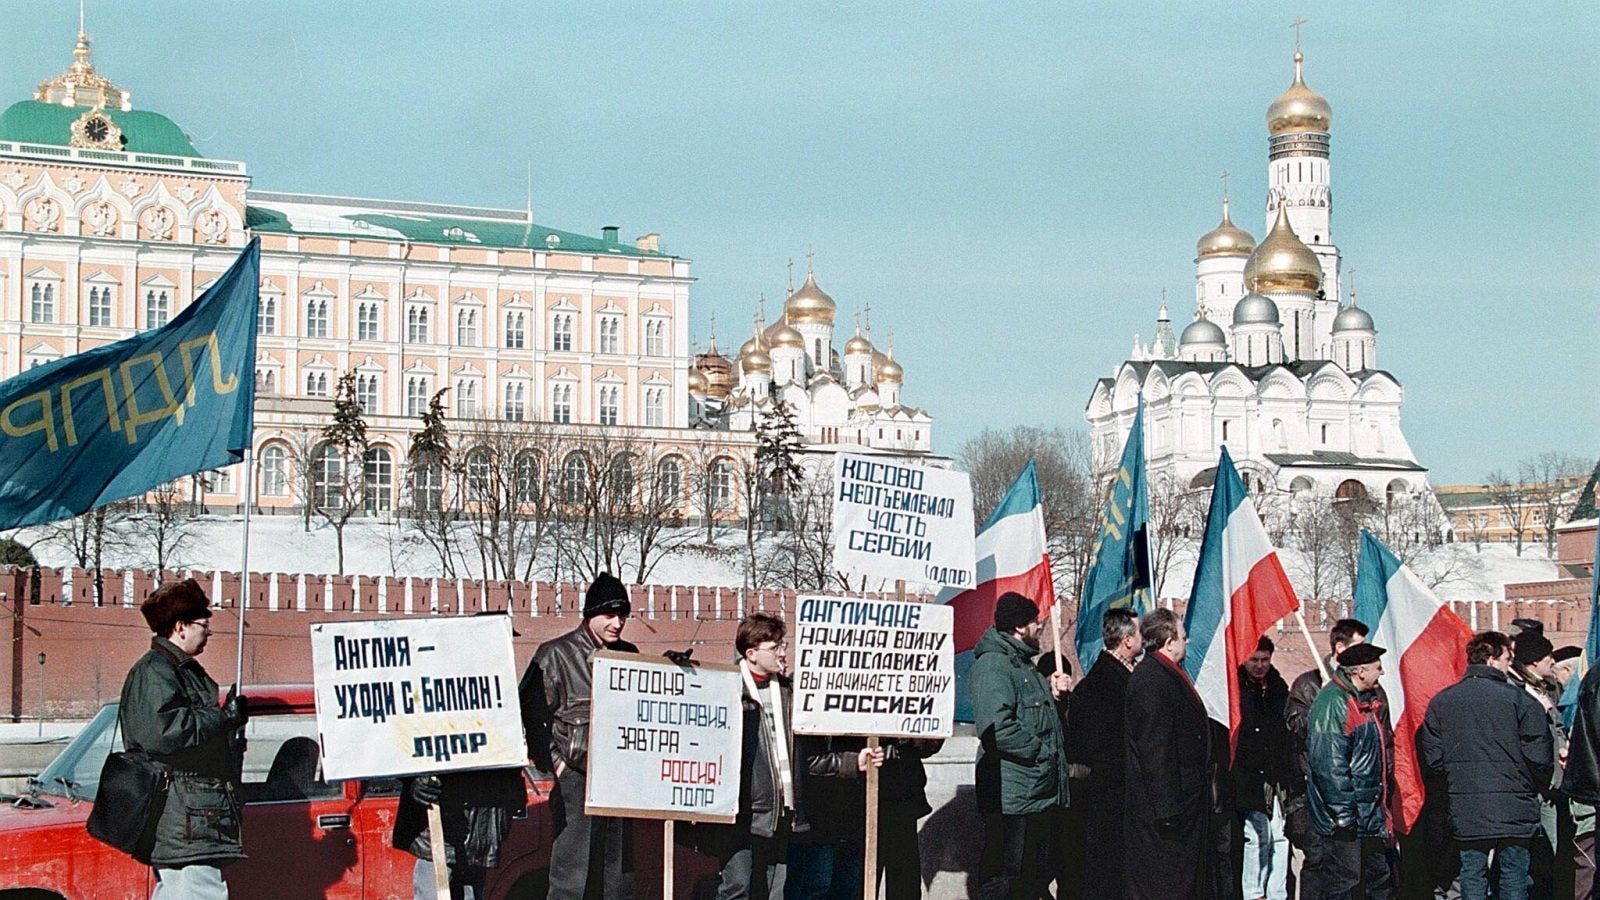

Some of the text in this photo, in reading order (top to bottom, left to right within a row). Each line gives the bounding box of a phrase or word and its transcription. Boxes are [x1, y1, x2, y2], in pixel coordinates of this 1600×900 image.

[842, 458, 924, 491] КОСОВО
[839, 481, 955, 519] НЕОТЪЕМЛЕМАЯ
[868, 508, 927, 538] ЧАСТЬ
[849, 530, 932, 561] СЕРБИИ
[925, 564, 972, 586] (ЛДПР)
[800, 599, 921, 629] АНГЛИЧАНЕ
[800, 627, 889, 648] НАЧИНАЯ
[800, 649, 813, 667] С
[609, 667, 685, 696] СЕГОДНЯ
[800, 671, 822, 690] ВЫ
[826, 672, 904, 692] НАЧИНАЕТЕ
[335, 675, 502, 724] УХОДИ С БАЛКАН!
[803, 693, 934, 715] С РОССИЕЙ
[617, 726, 679, 753] ЗАВТРА
[901, 717, 940, 734] ЛДПР
[412, 732, 487, 763] ЛДПР
[661, 754, 723, 785] РОССИЯ!
[671, 786, 714, 807] ЛДПР
